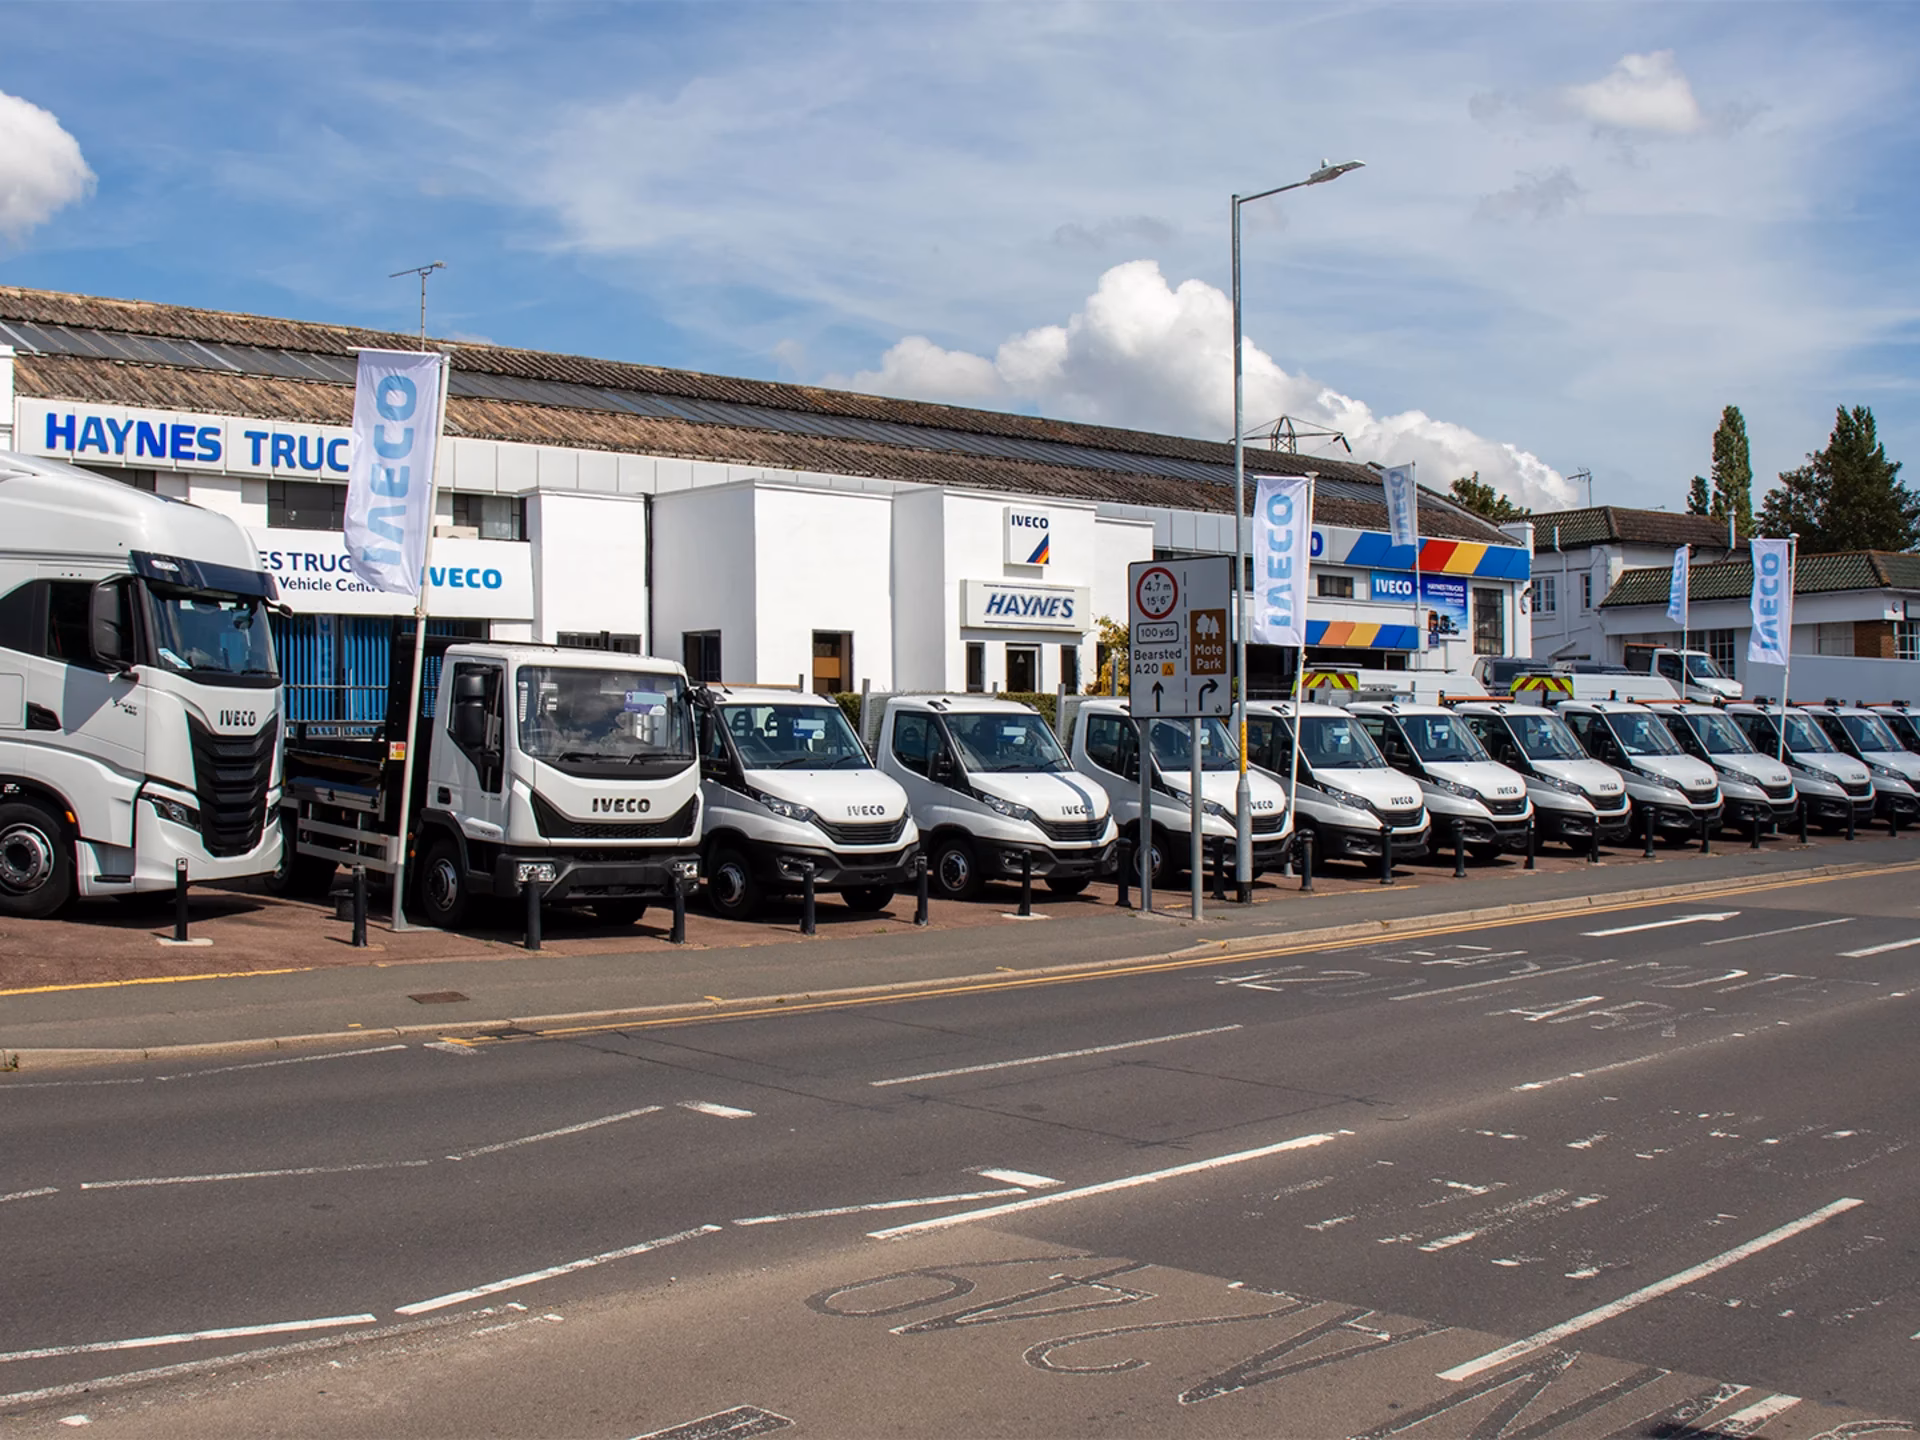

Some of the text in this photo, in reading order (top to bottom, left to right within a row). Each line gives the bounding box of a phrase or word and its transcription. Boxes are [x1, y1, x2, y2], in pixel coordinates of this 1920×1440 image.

[46, 412, 349, 472] HAYNES TRUC
[1011, 514, 1049, 529] IVECO
[287, 552, 352, 573] TRUC
[279, 576, 332, 591] Vehicle
[1145, 581, 1171, 592] 4.7 m
[1376, 578, 1412, 595] IVECO
[984, 593, 1075, 618] HAYNES
[1141, 628, 1174, 640] 100 yds
[1134, 648, 1182, 661] Bearsted
[1195, 644, 1222, 656] Mote
[1135, 663, 1159, 675] A20
[1196, 657, 1221, 670] Park
[219, 709, 256, 727] IVECO
[592, 798, 650, 813] IVECO
[1250, 800, 1273, 811] VECO
[1391, 795, 1414, 805] IVECO
[847, 804, 885, 816] IVECO
